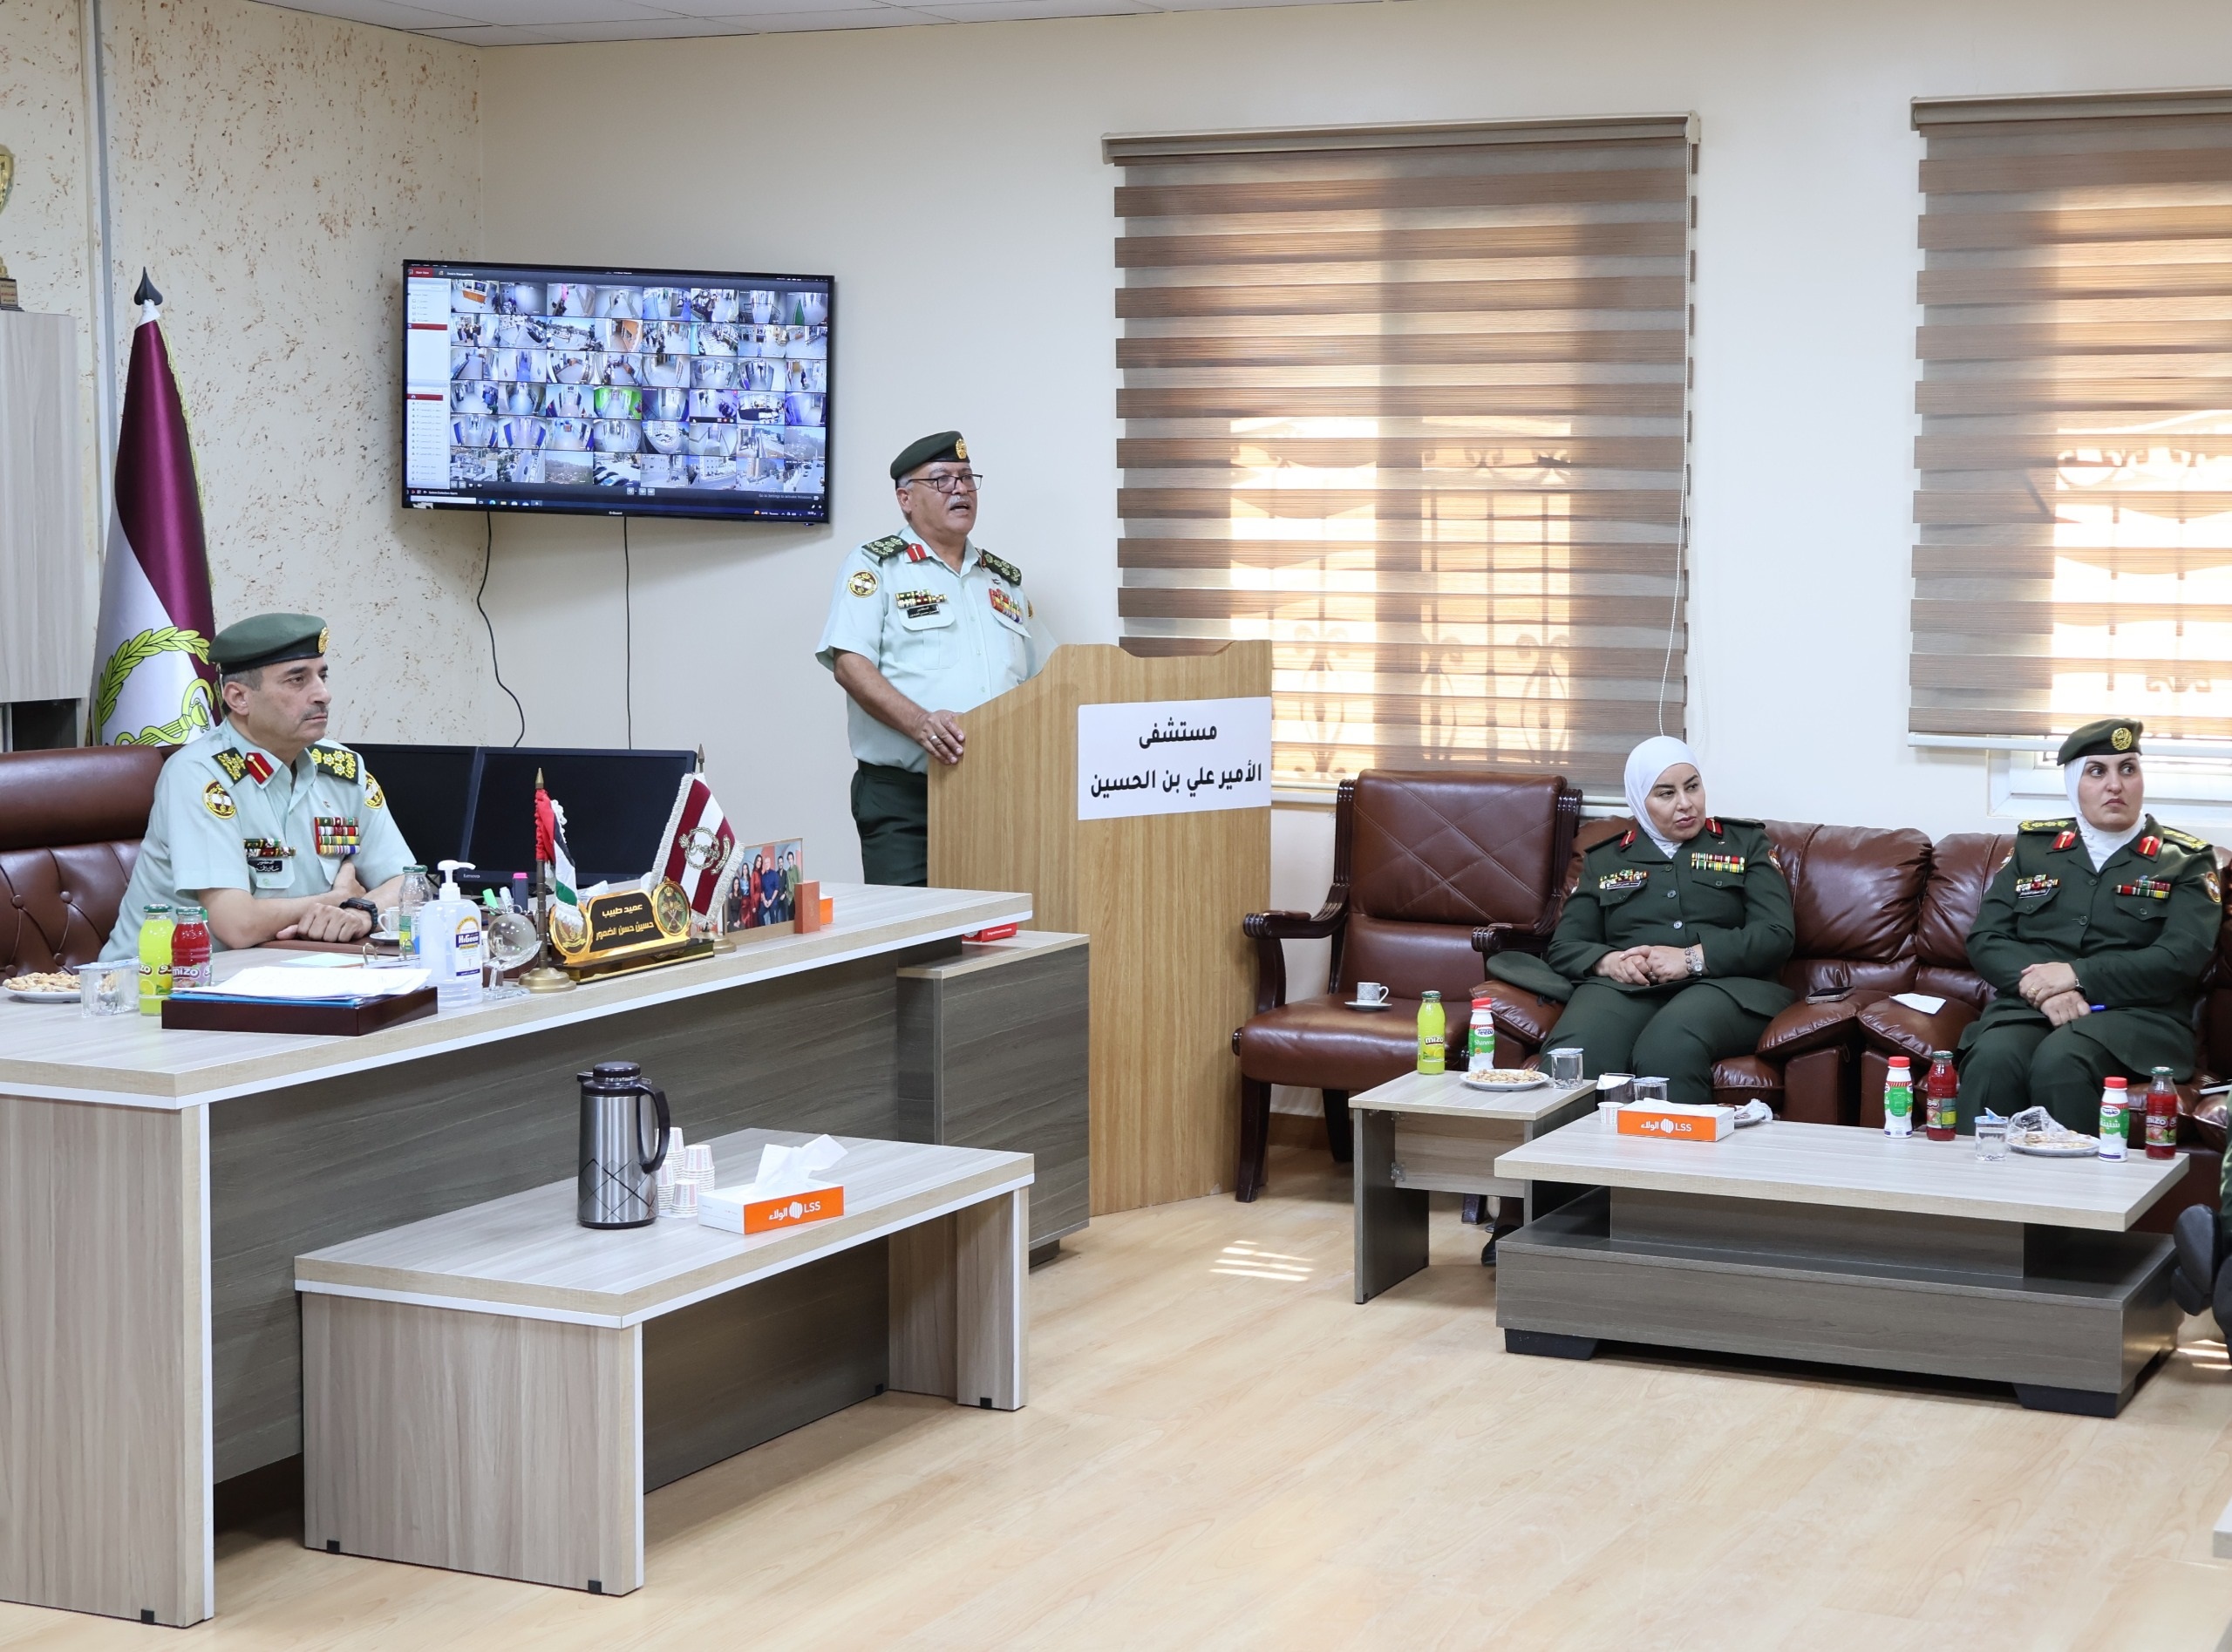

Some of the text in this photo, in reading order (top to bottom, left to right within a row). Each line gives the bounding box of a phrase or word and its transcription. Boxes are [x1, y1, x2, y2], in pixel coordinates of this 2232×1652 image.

[1139, 717, 1217, 749] مستشفى
[1090, 759, 1262, 799] الأمير علي بن الحسين
[602, 904, 643, 919] عميد طبيب
[618, 925, 635, 936] حسن
[635, 921, 654, 933] حسين
[1425, 1036, 1444, 1045] mizo
[1675, 1122, 1692, 1132] LSS
[803, 1201, 821, 1213] LSS
